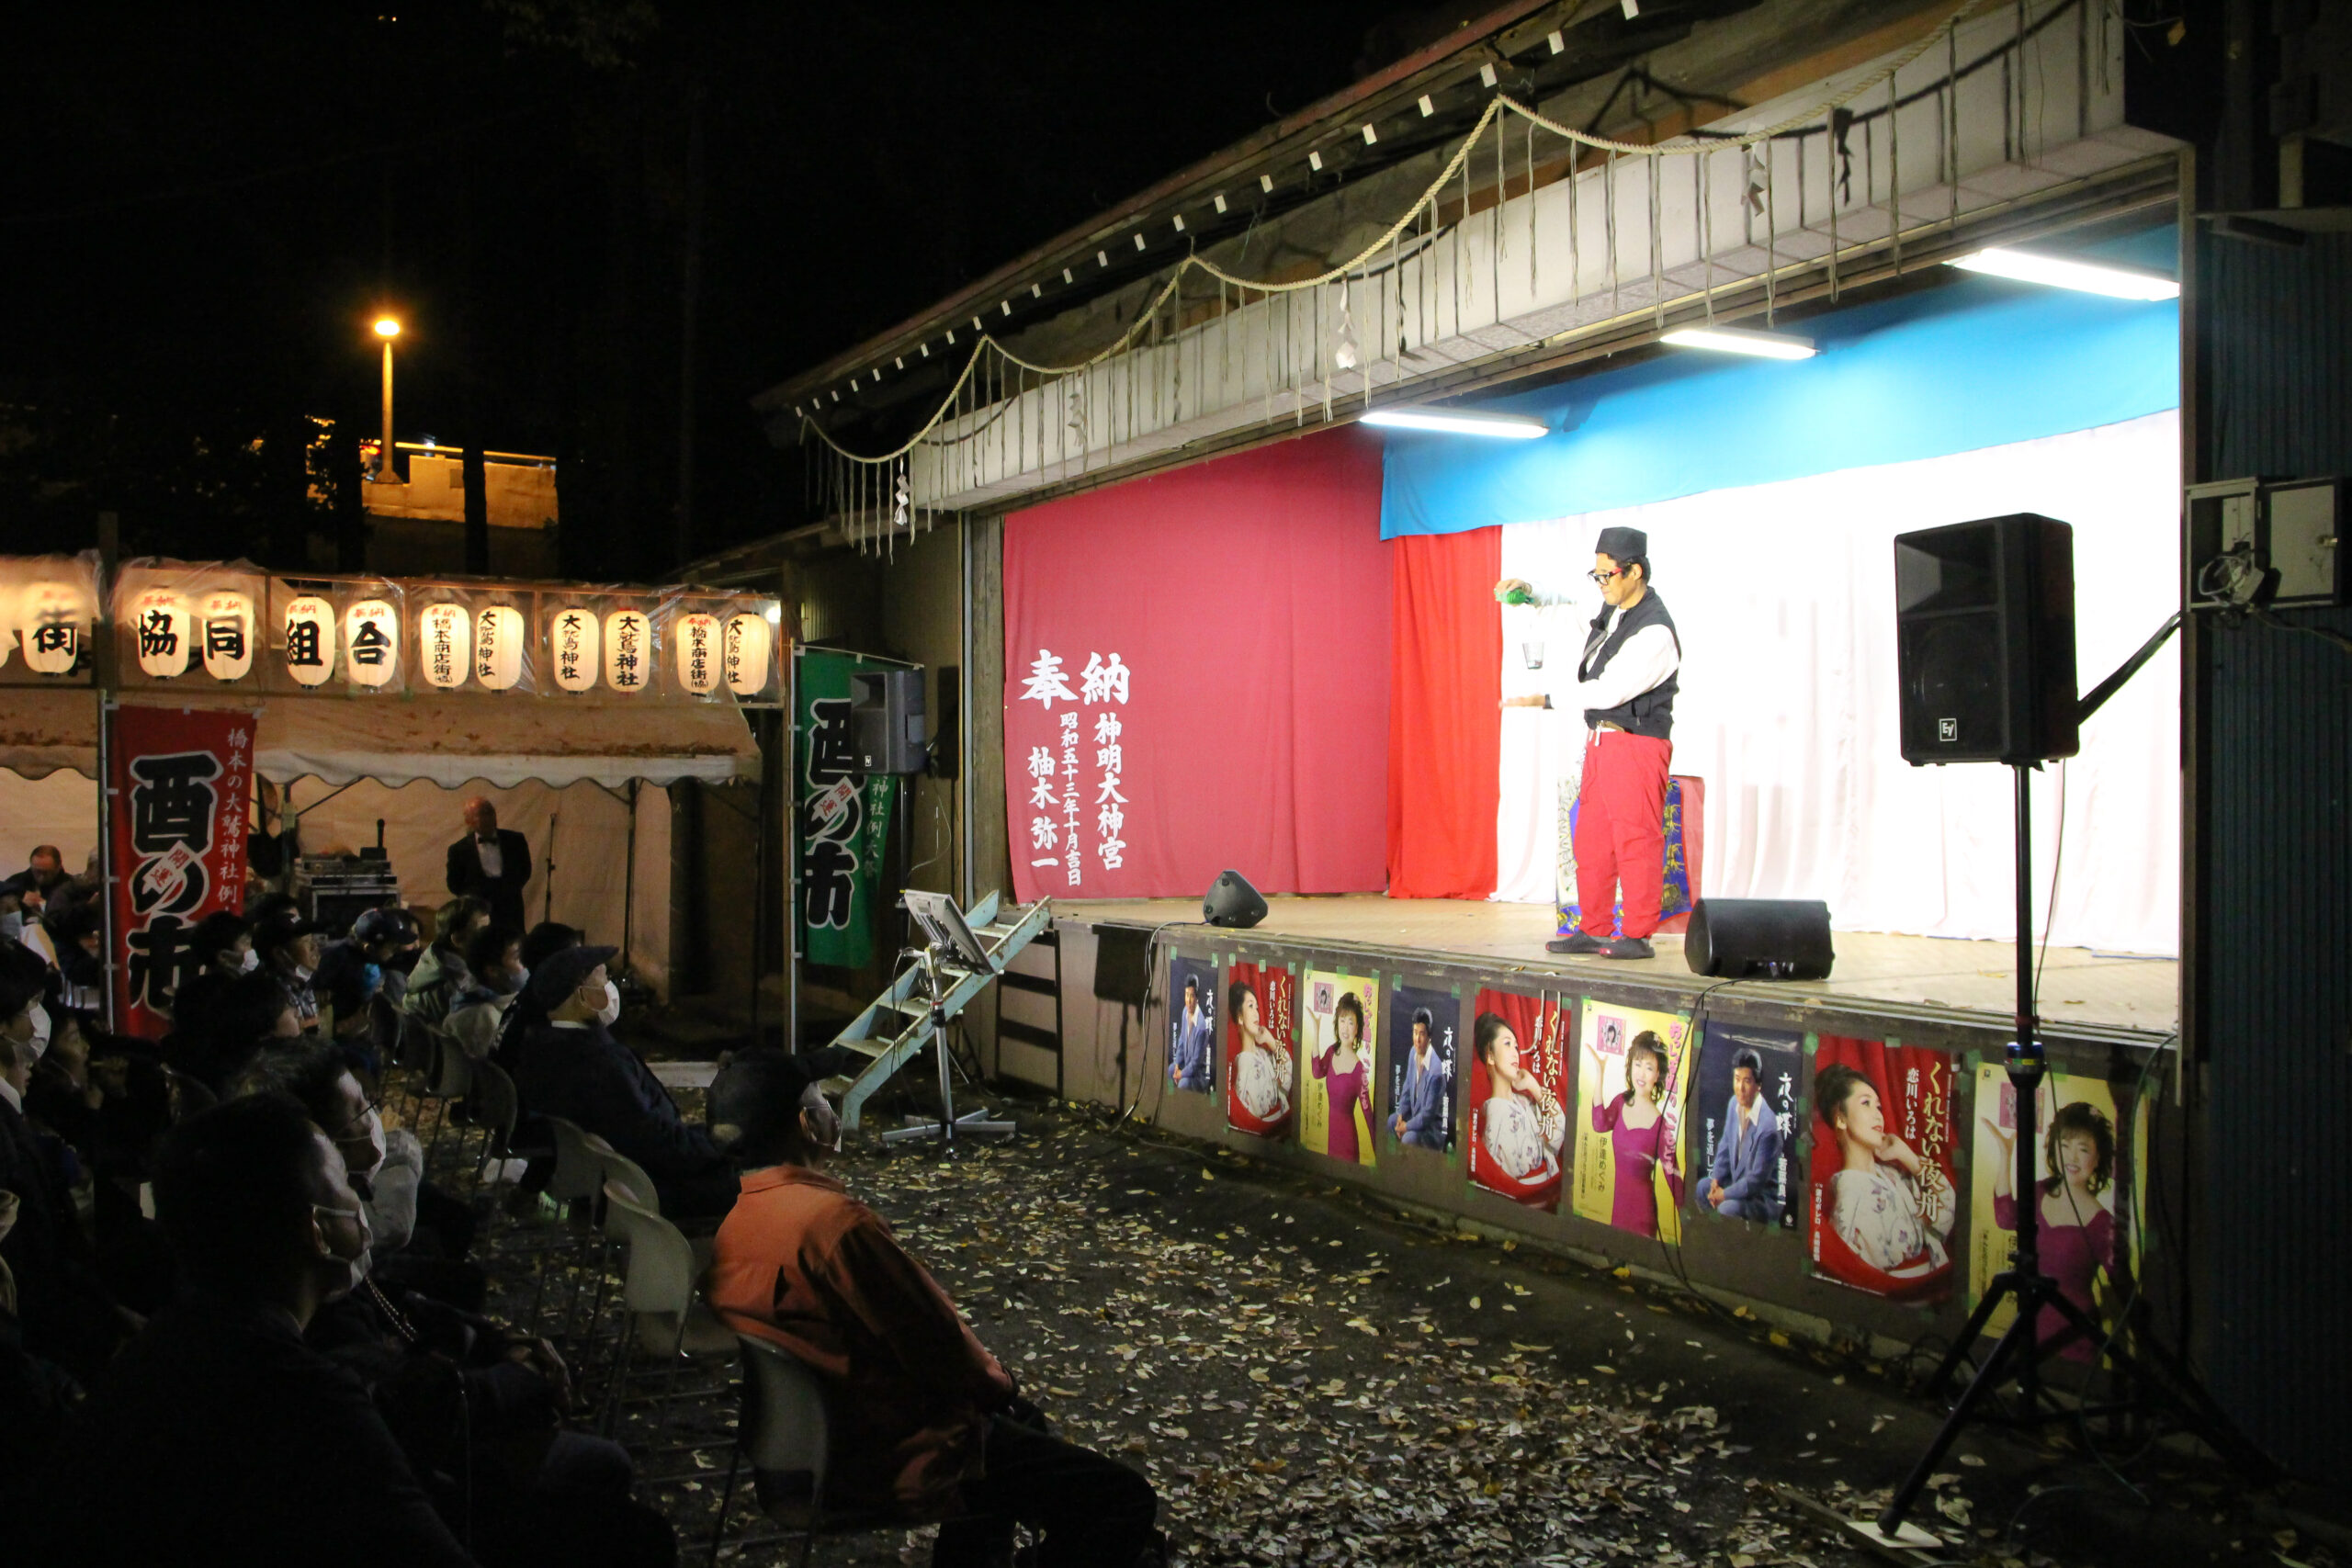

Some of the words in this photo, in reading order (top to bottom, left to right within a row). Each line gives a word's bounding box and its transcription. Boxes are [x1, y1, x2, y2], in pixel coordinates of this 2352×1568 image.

[1018, 649, 1131, 711] 奉納
[217, 728, 247, 910] 橋本の大鷲神社例
[863, 777, 888, 878] 神社例大祭
[1059, 711, 1081, 886] 昭和五十三年十月吉日
[1093, 712, 1129, 871] 神明大神宮
[1905, 1067, 1919, 1139] 恋川いろは
[1917, 1061, 1945, 1223] くれない夜舟
